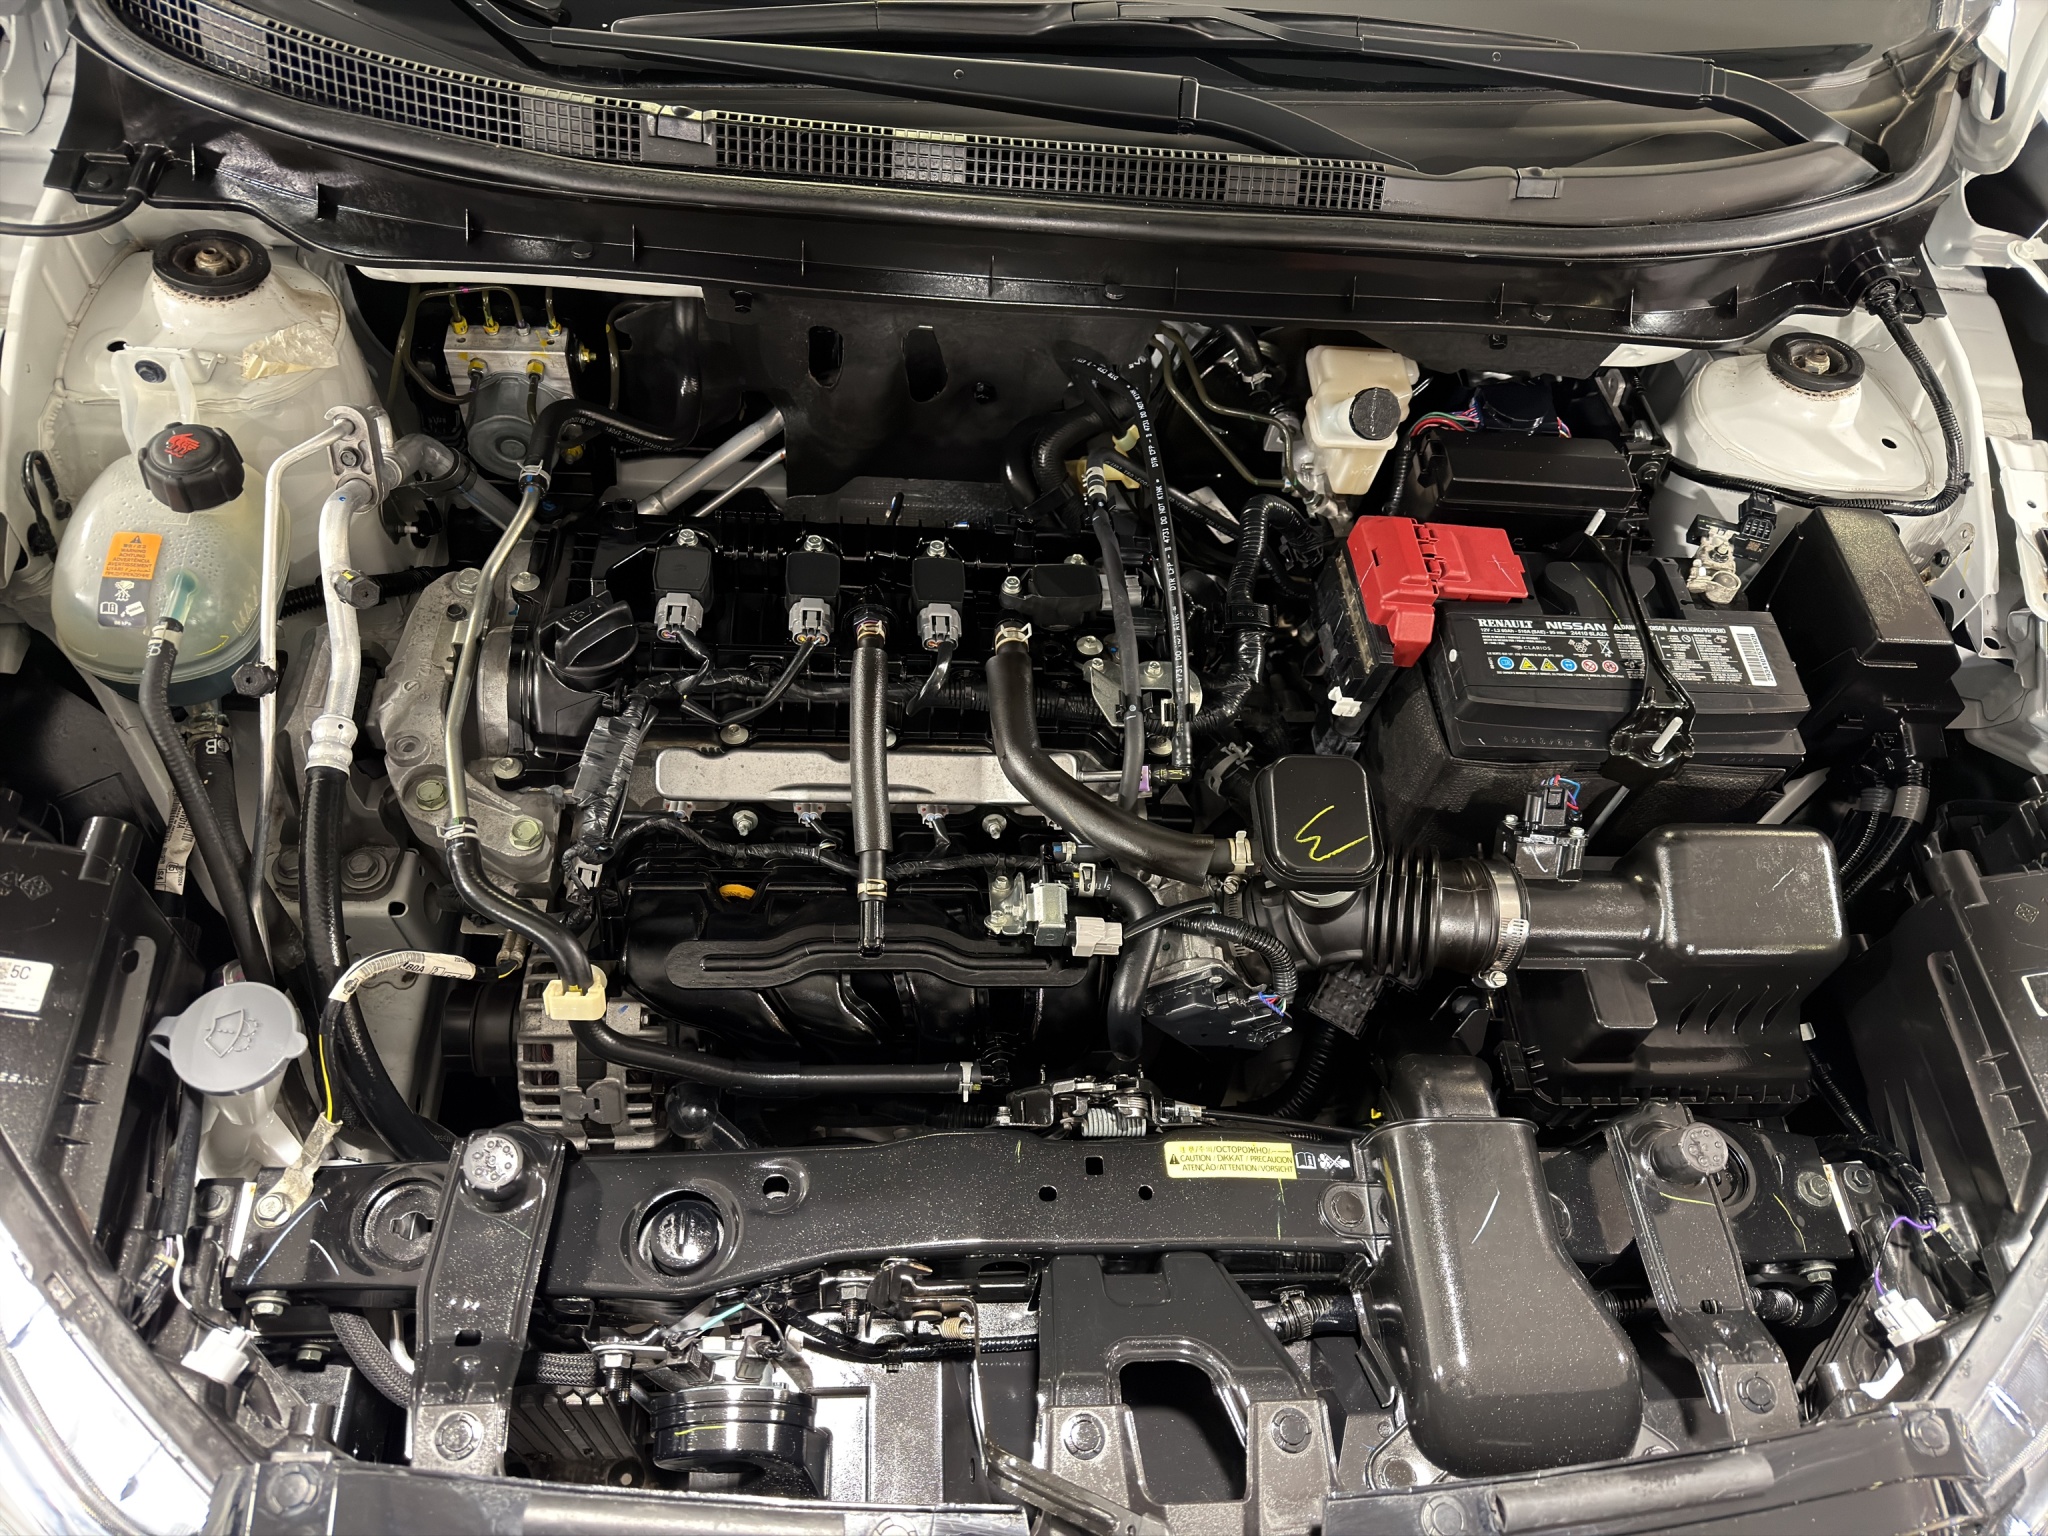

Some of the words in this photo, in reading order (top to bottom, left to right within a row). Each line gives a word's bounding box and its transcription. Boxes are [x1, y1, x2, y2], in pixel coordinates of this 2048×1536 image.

[1156, 486, 1164, 500] KINK
[1158, 503, 1166, 514] NOT
[1160, 516, 1168, 525] DO
[1162, 528, 1170, 543] 4731
[1478, 618, 1533, 629] RENAULT
[1545, 621, 1607, 631] NISSAN
[1175, 650, 1182, 661] DO
[10, 964, 31, 980] 5C
[1180, 1154, 1211, 1162] CAUTION
